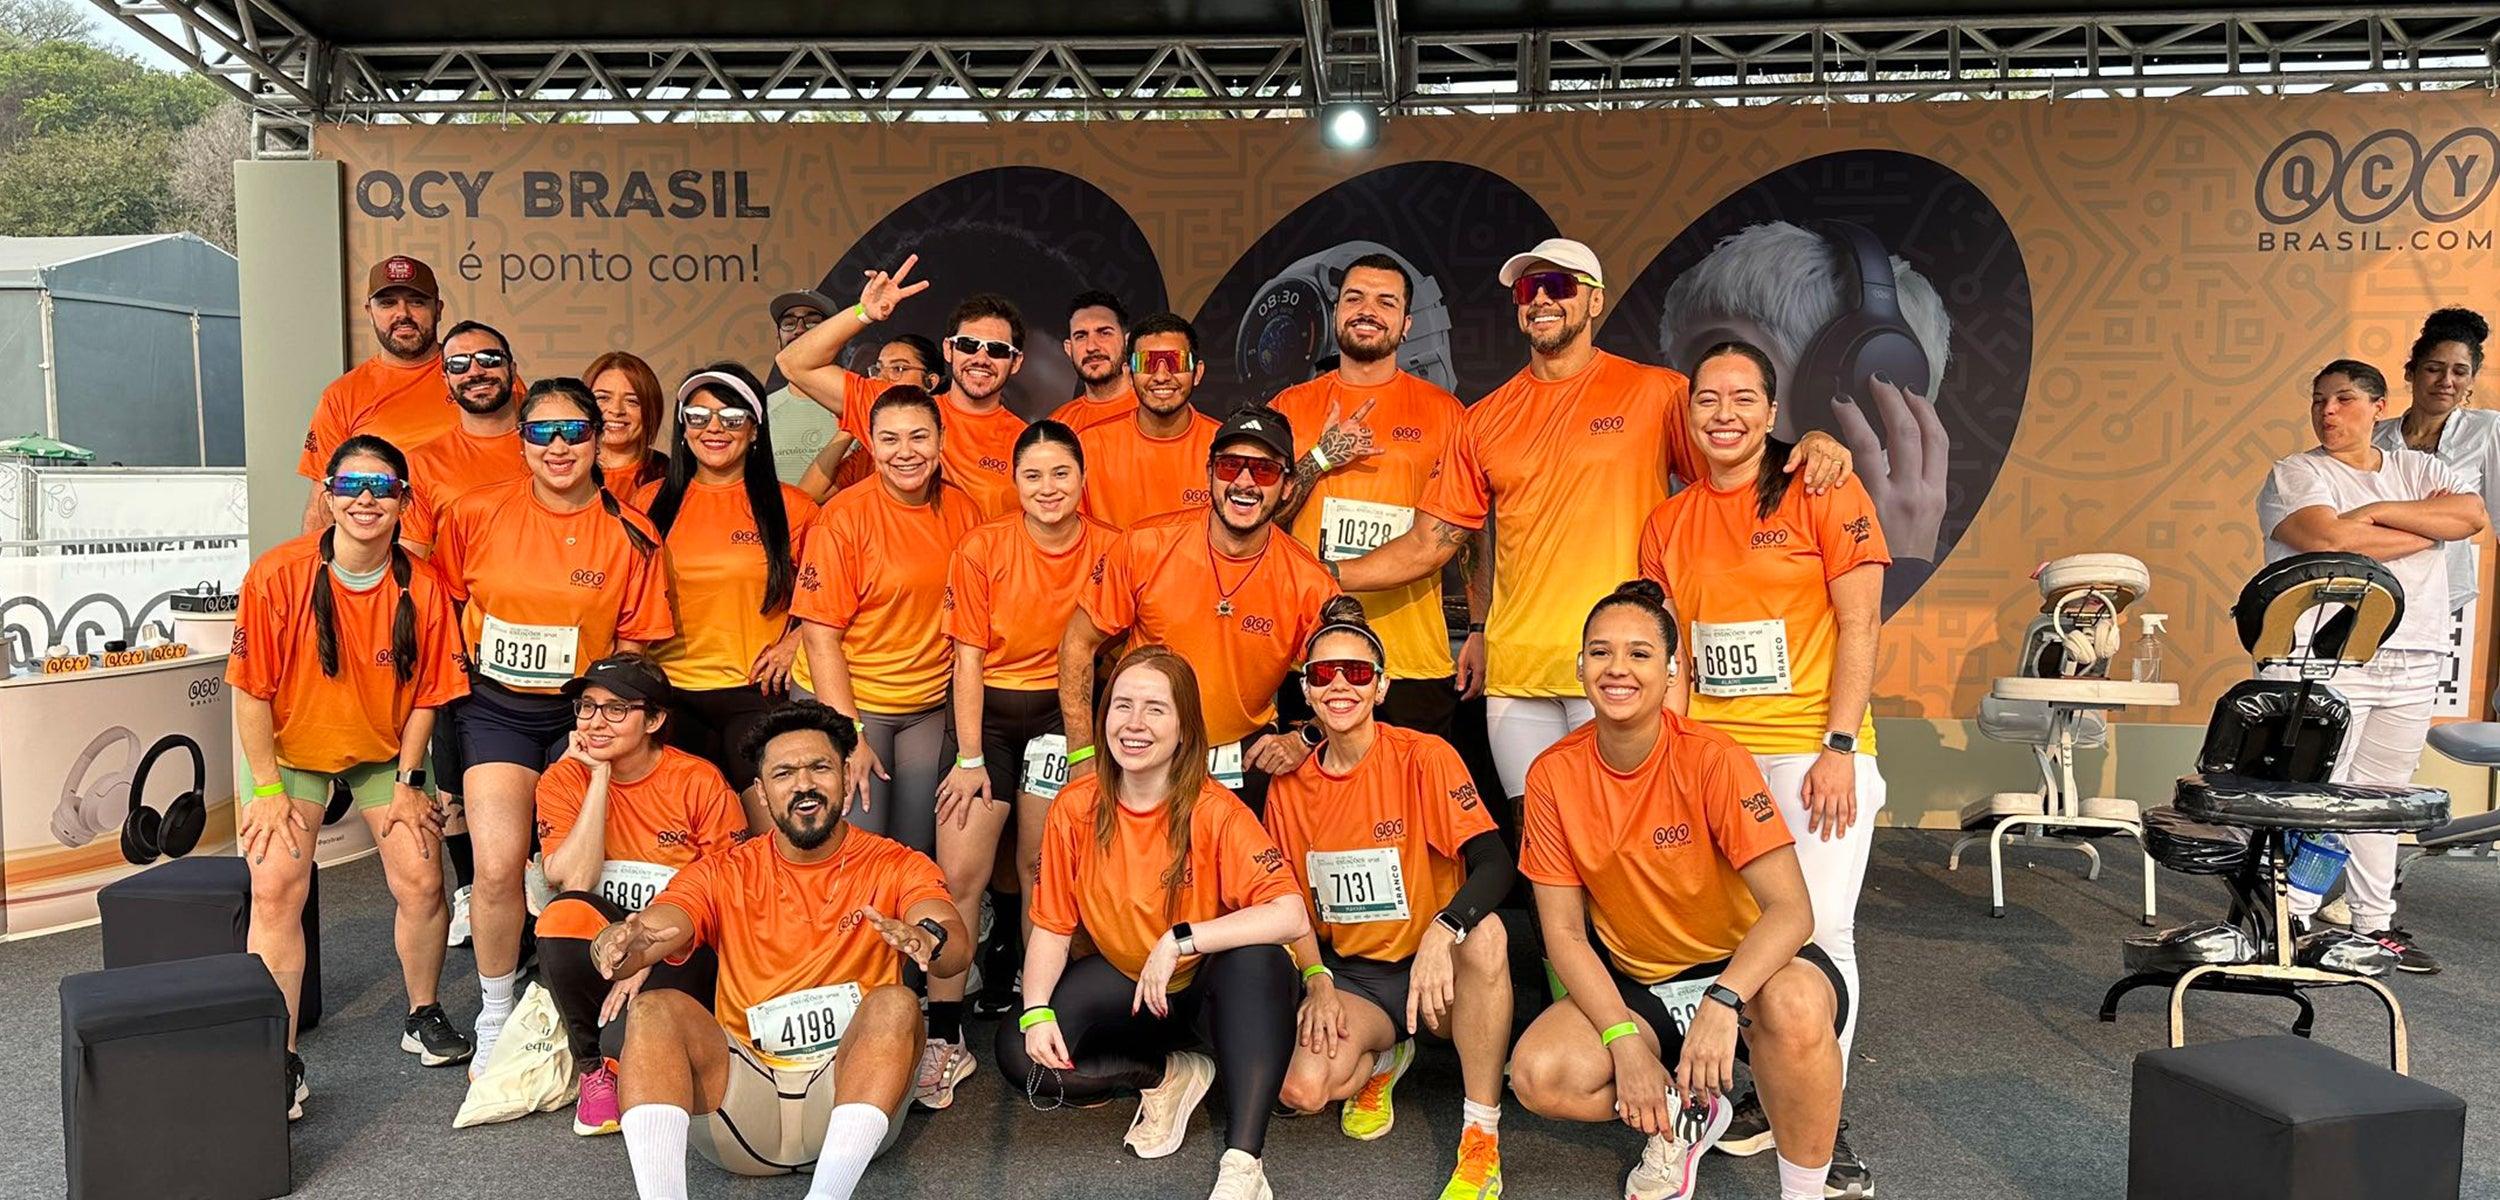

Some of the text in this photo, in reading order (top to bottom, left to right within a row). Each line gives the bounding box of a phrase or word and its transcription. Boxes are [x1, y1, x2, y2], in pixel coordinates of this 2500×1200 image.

[356, 170, 770, 221] QCY BRASIL
[2257, 230, 2492, 252] BRASIL.COM
[459, 241, 760, 294] é ponto com!
[1258, 290, 1300, 316] 08:30
[1338, 518, 1391, 548] 10328
[495, 638, 547, 669] 8330
[1705, 643, 1757, 676] 6895
[1775, 636, 1787, 678] BRANCO
[189, 676, 220, 700] QCY
[1653, 823, 1689, 845] QCY
[603, 880, 656, 909] 6892
[1330, 871, 1375, 903] 7131
[1391, 864, 1404, 905] BRANCO
[781, 1006, 836, 1048] 4198
